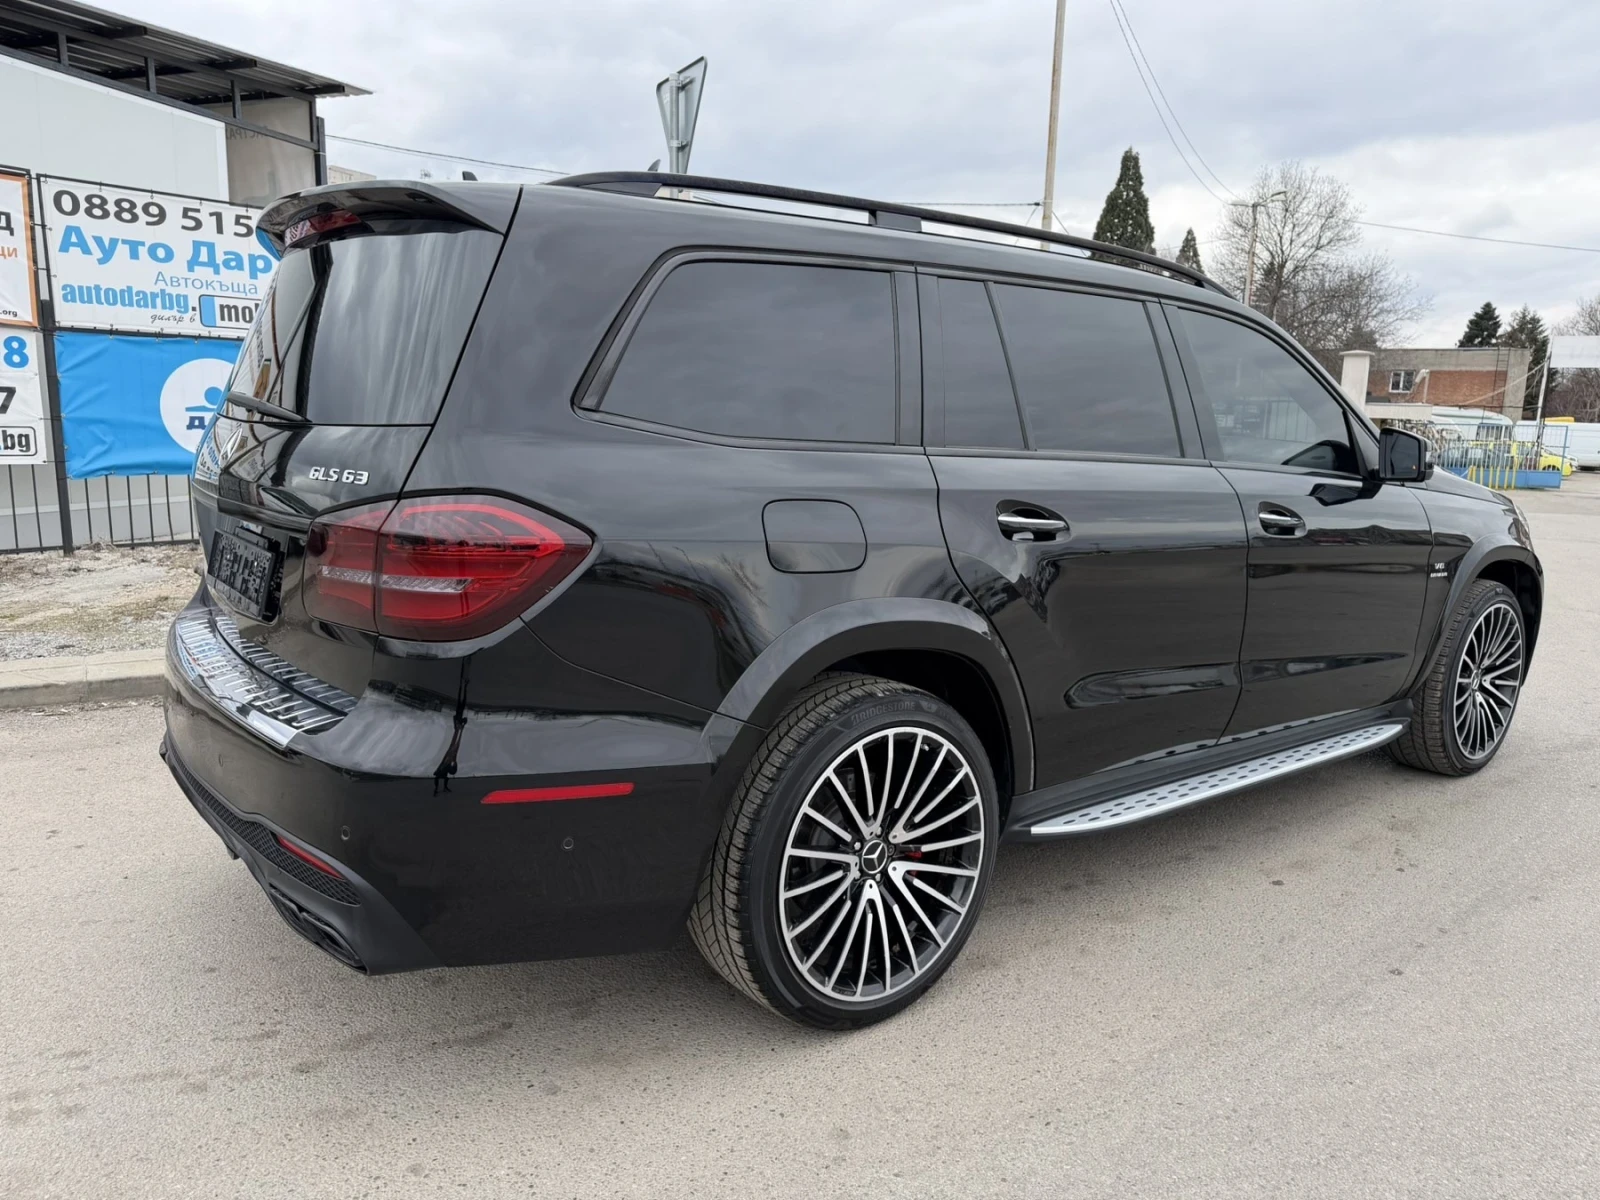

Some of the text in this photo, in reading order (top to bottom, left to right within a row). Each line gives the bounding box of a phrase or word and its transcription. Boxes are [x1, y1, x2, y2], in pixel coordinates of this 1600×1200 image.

[53, 189, 167, 226] 0889
[181, 206, 254, 239] 515
[58, 224, 273, 280] Ауто Дар
[154, 271, 258, 296] Автокъща
[3, 335, 29, 369] 8
[0, 386, 17, 415] 7
[309, 465, 369, 486] GLS 63
